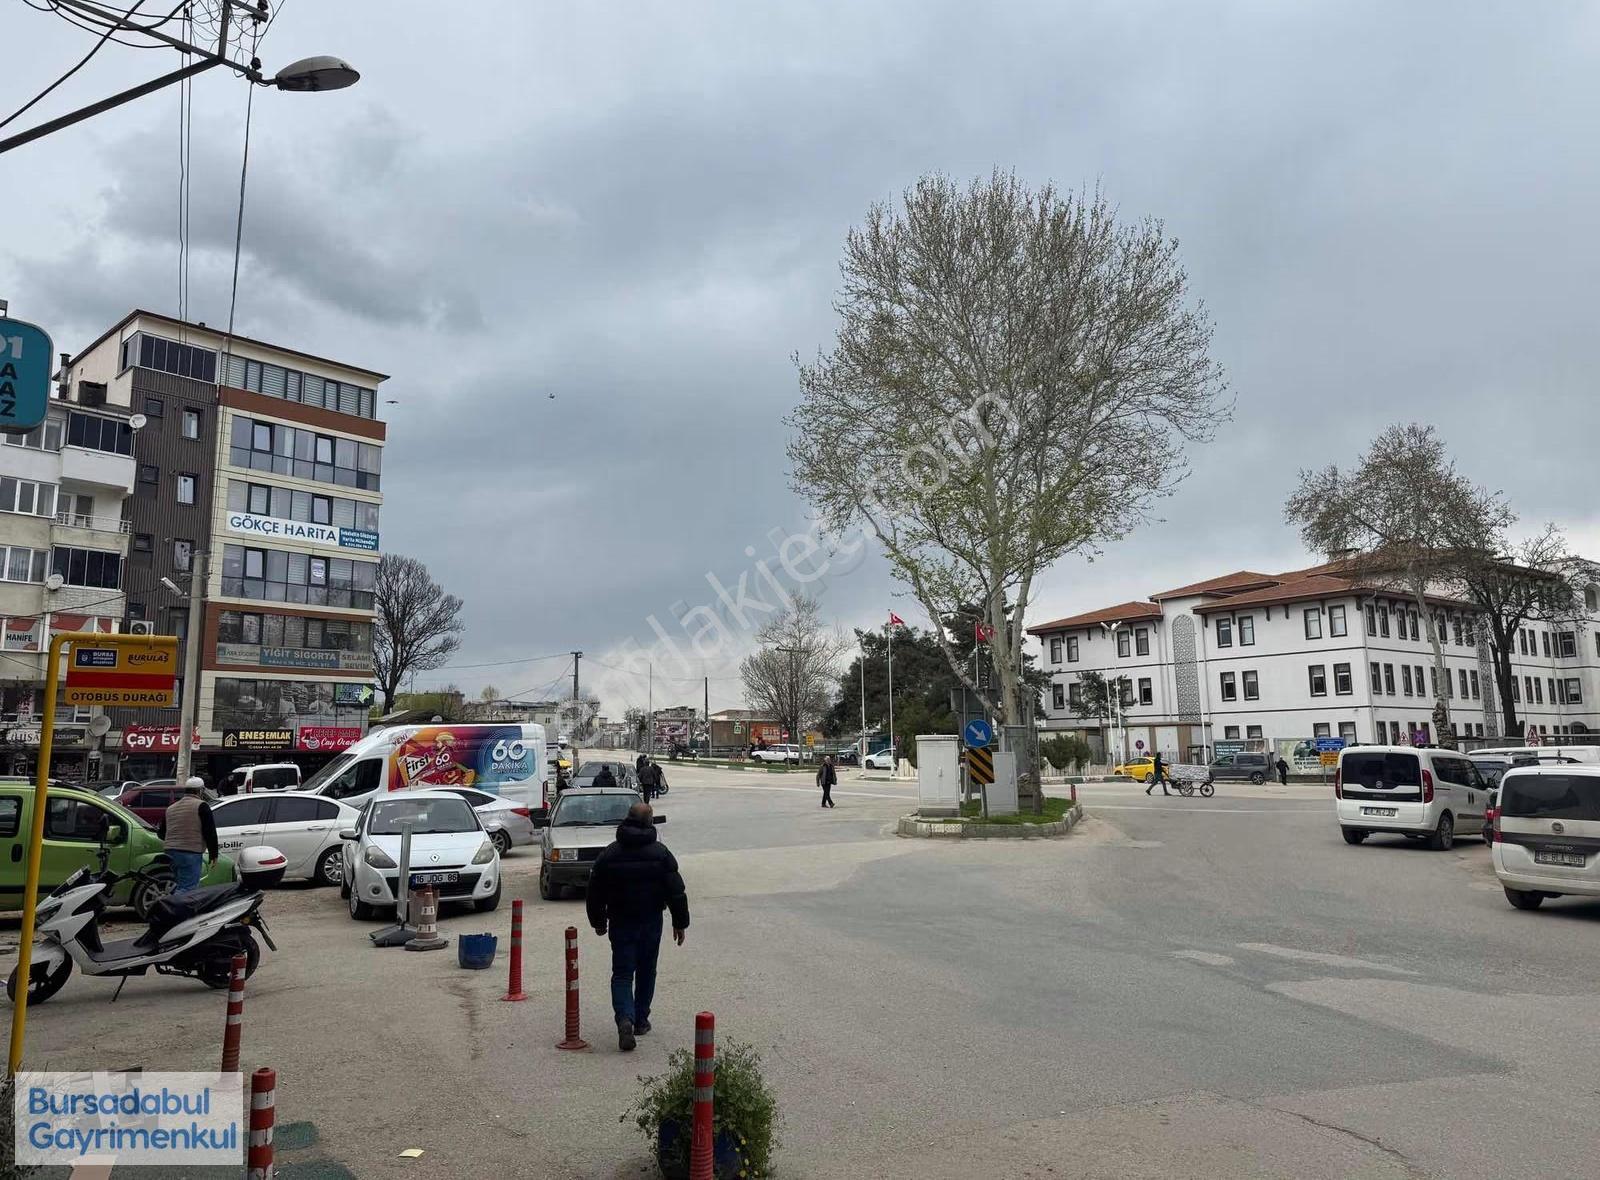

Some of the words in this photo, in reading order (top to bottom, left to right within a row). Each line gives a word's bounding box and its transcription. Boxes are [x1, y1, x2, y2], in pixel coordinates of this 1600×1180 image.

[230, 515, 279, 534] GÖKÇE
[126, 733, 155, 748] Çay
[240, 731, 265, 740] ENES
[265, 731, 291, 740] EMLAK
[492, 740, 527, 761] 60
[435, 753, 450, 766] 60
